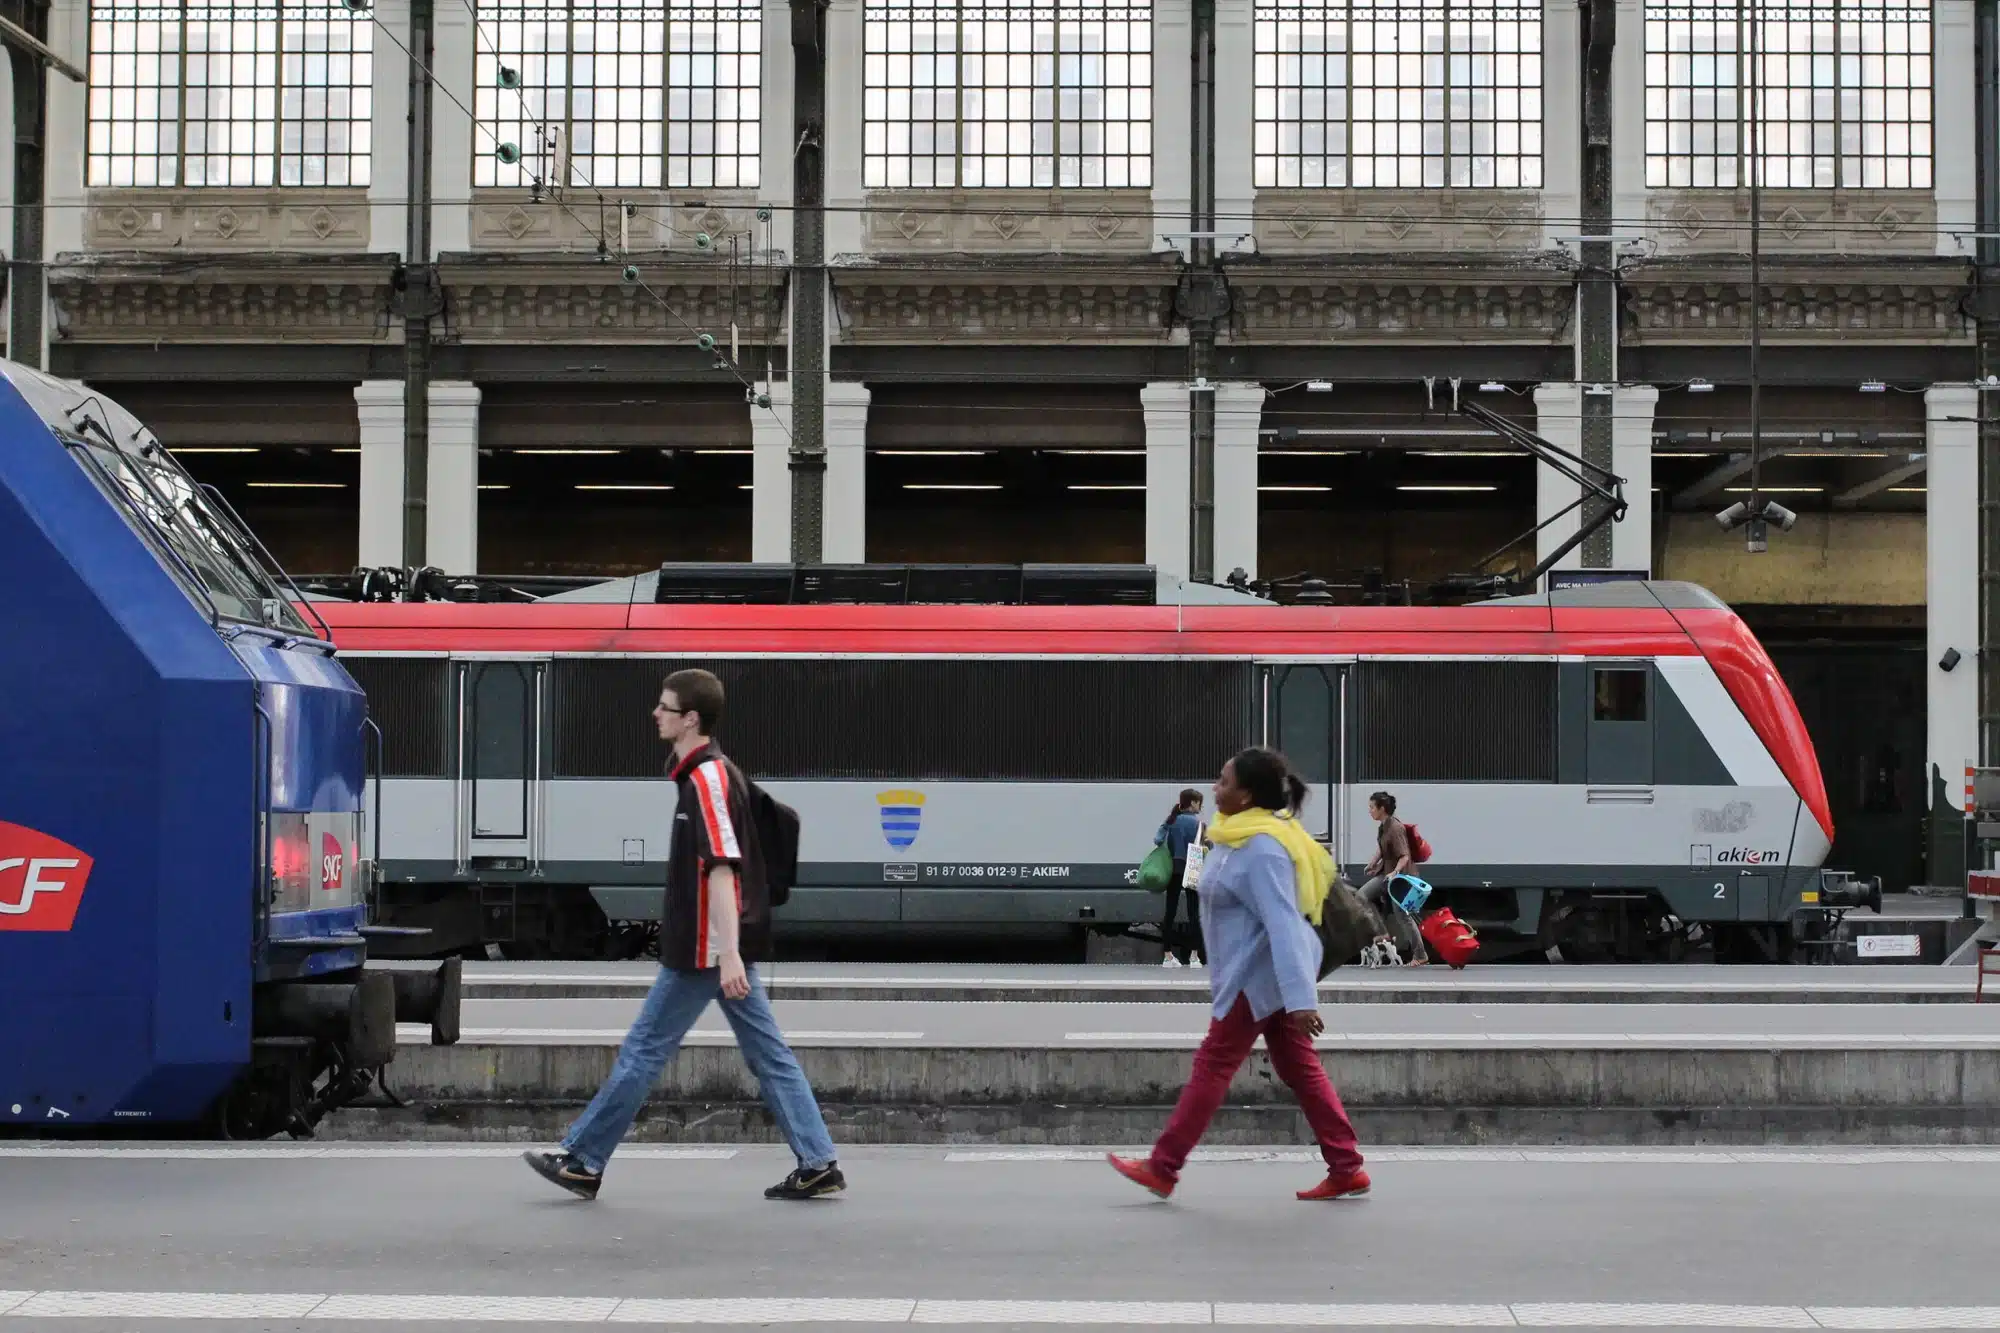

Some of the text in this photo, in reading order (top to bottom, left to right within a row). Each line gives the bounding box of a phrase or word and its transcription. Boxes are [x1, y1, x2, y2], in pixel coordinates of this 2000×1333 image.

[1717, 847, 1780, 864] akiem
[323, 854, 342, 882] SNCF
[926, 866, 938, 876] 91
[942, 866, 955, 876] 87
[959, 866, 983, 876] 0036
[987, 866, 1017, 876] 012-9
[1713, 882, 1725, 899] 2
